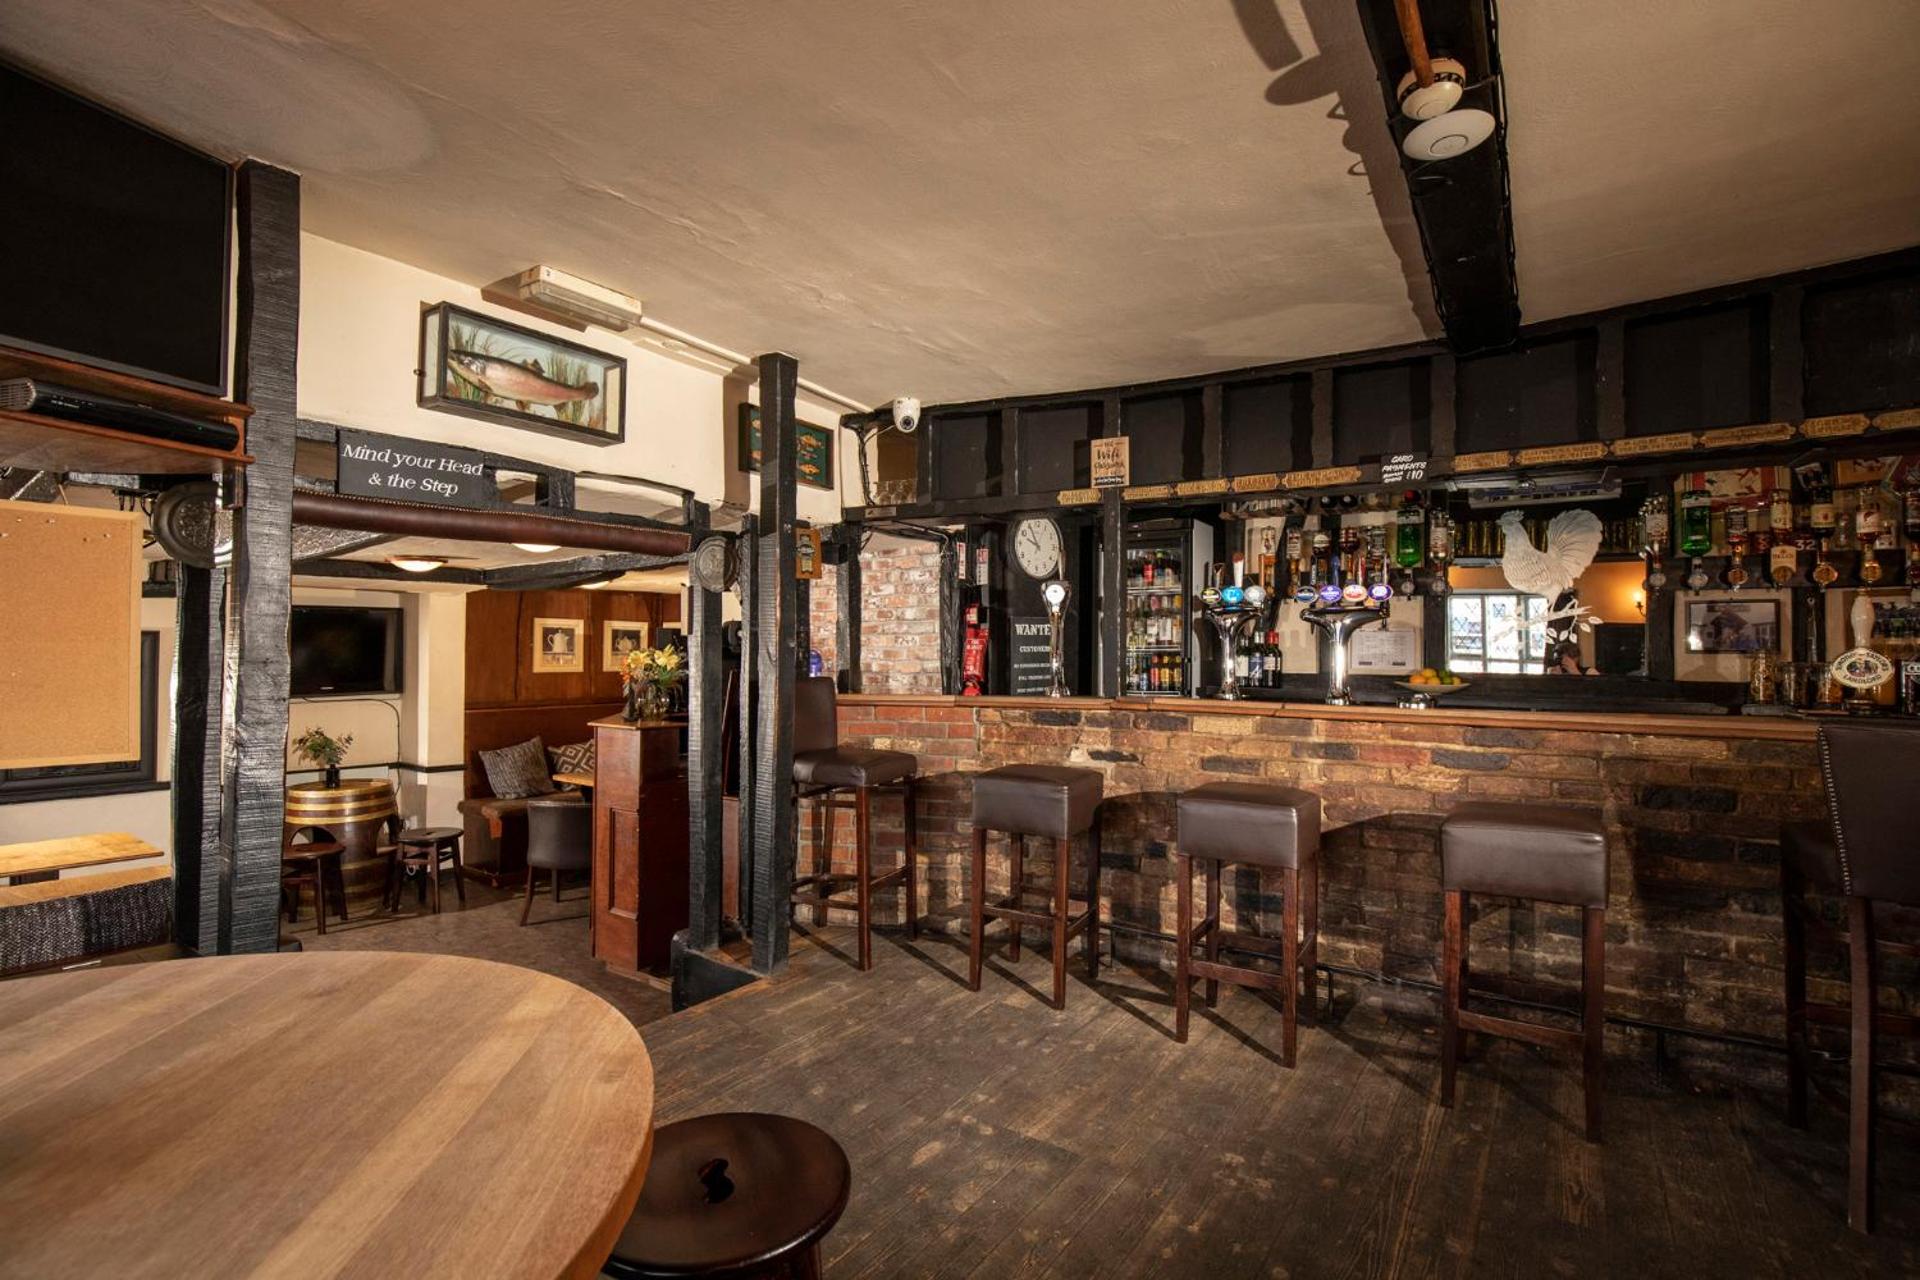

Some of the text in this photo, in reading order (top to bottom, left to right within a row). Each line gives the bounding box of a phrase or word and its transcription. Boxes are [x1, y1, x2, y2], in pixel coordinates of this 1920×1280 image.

[342, 443, 485, 476] Mind your Head
[1391, 454, 1414, 463] CARD
[1382, 462, 1427, 473] PAYMENTS
[368, 473, 459, 498] & the Step
[1795, 540, 1816, 551] 32
[1015, 623, 1052, 636] WANTE
